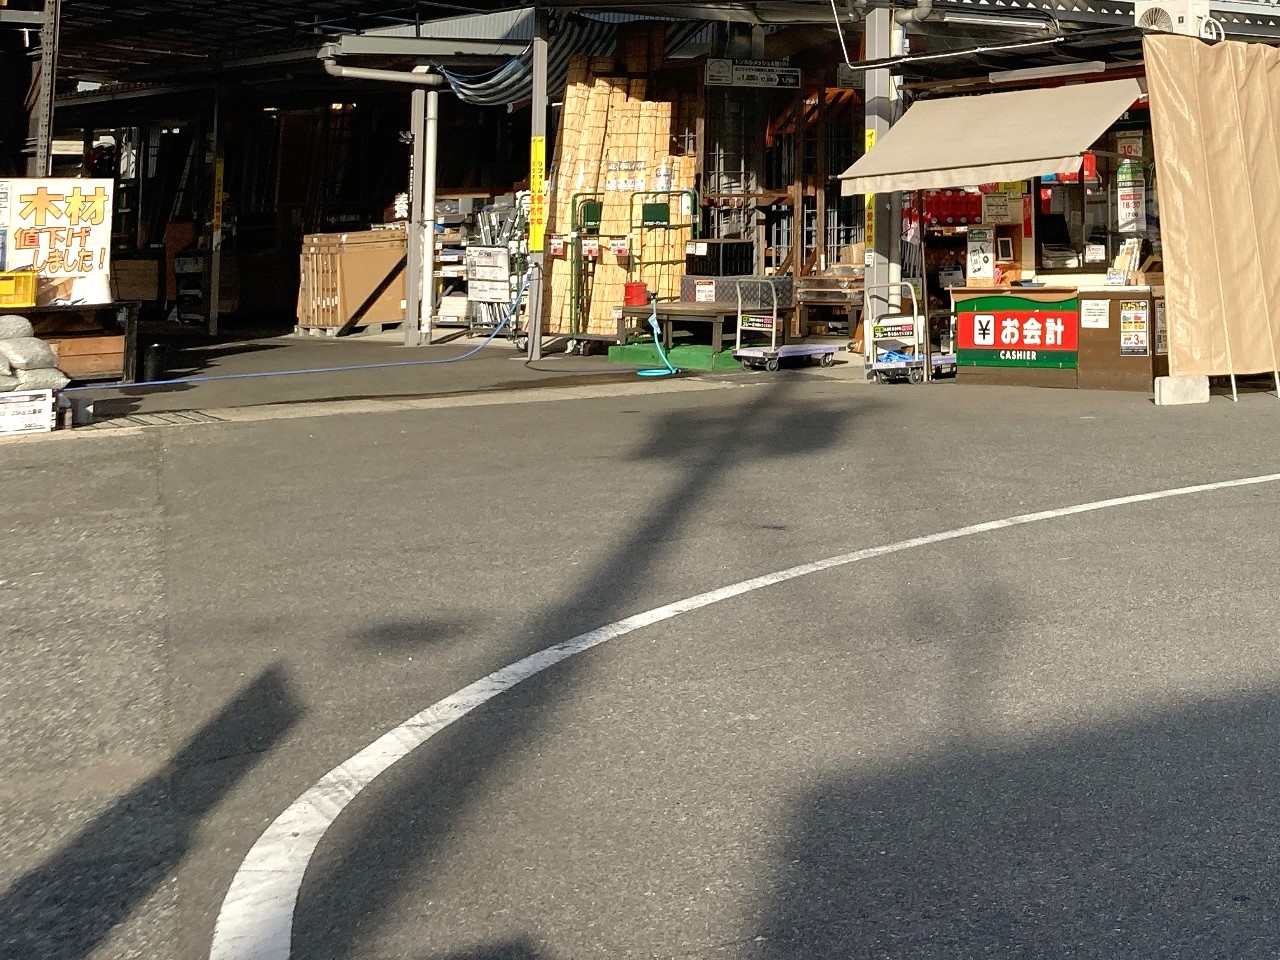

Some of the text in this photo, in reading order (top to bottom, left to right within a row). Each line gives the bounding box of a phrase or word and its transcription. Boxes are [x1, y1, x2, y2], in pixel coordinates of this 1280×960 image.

[19, 187, 109, 226] 木材
[14, 227, 91, 250] 値下げ
[1001, 317, 1065, 345] お会計
[999, 350, 1037, 360] CASHIER
